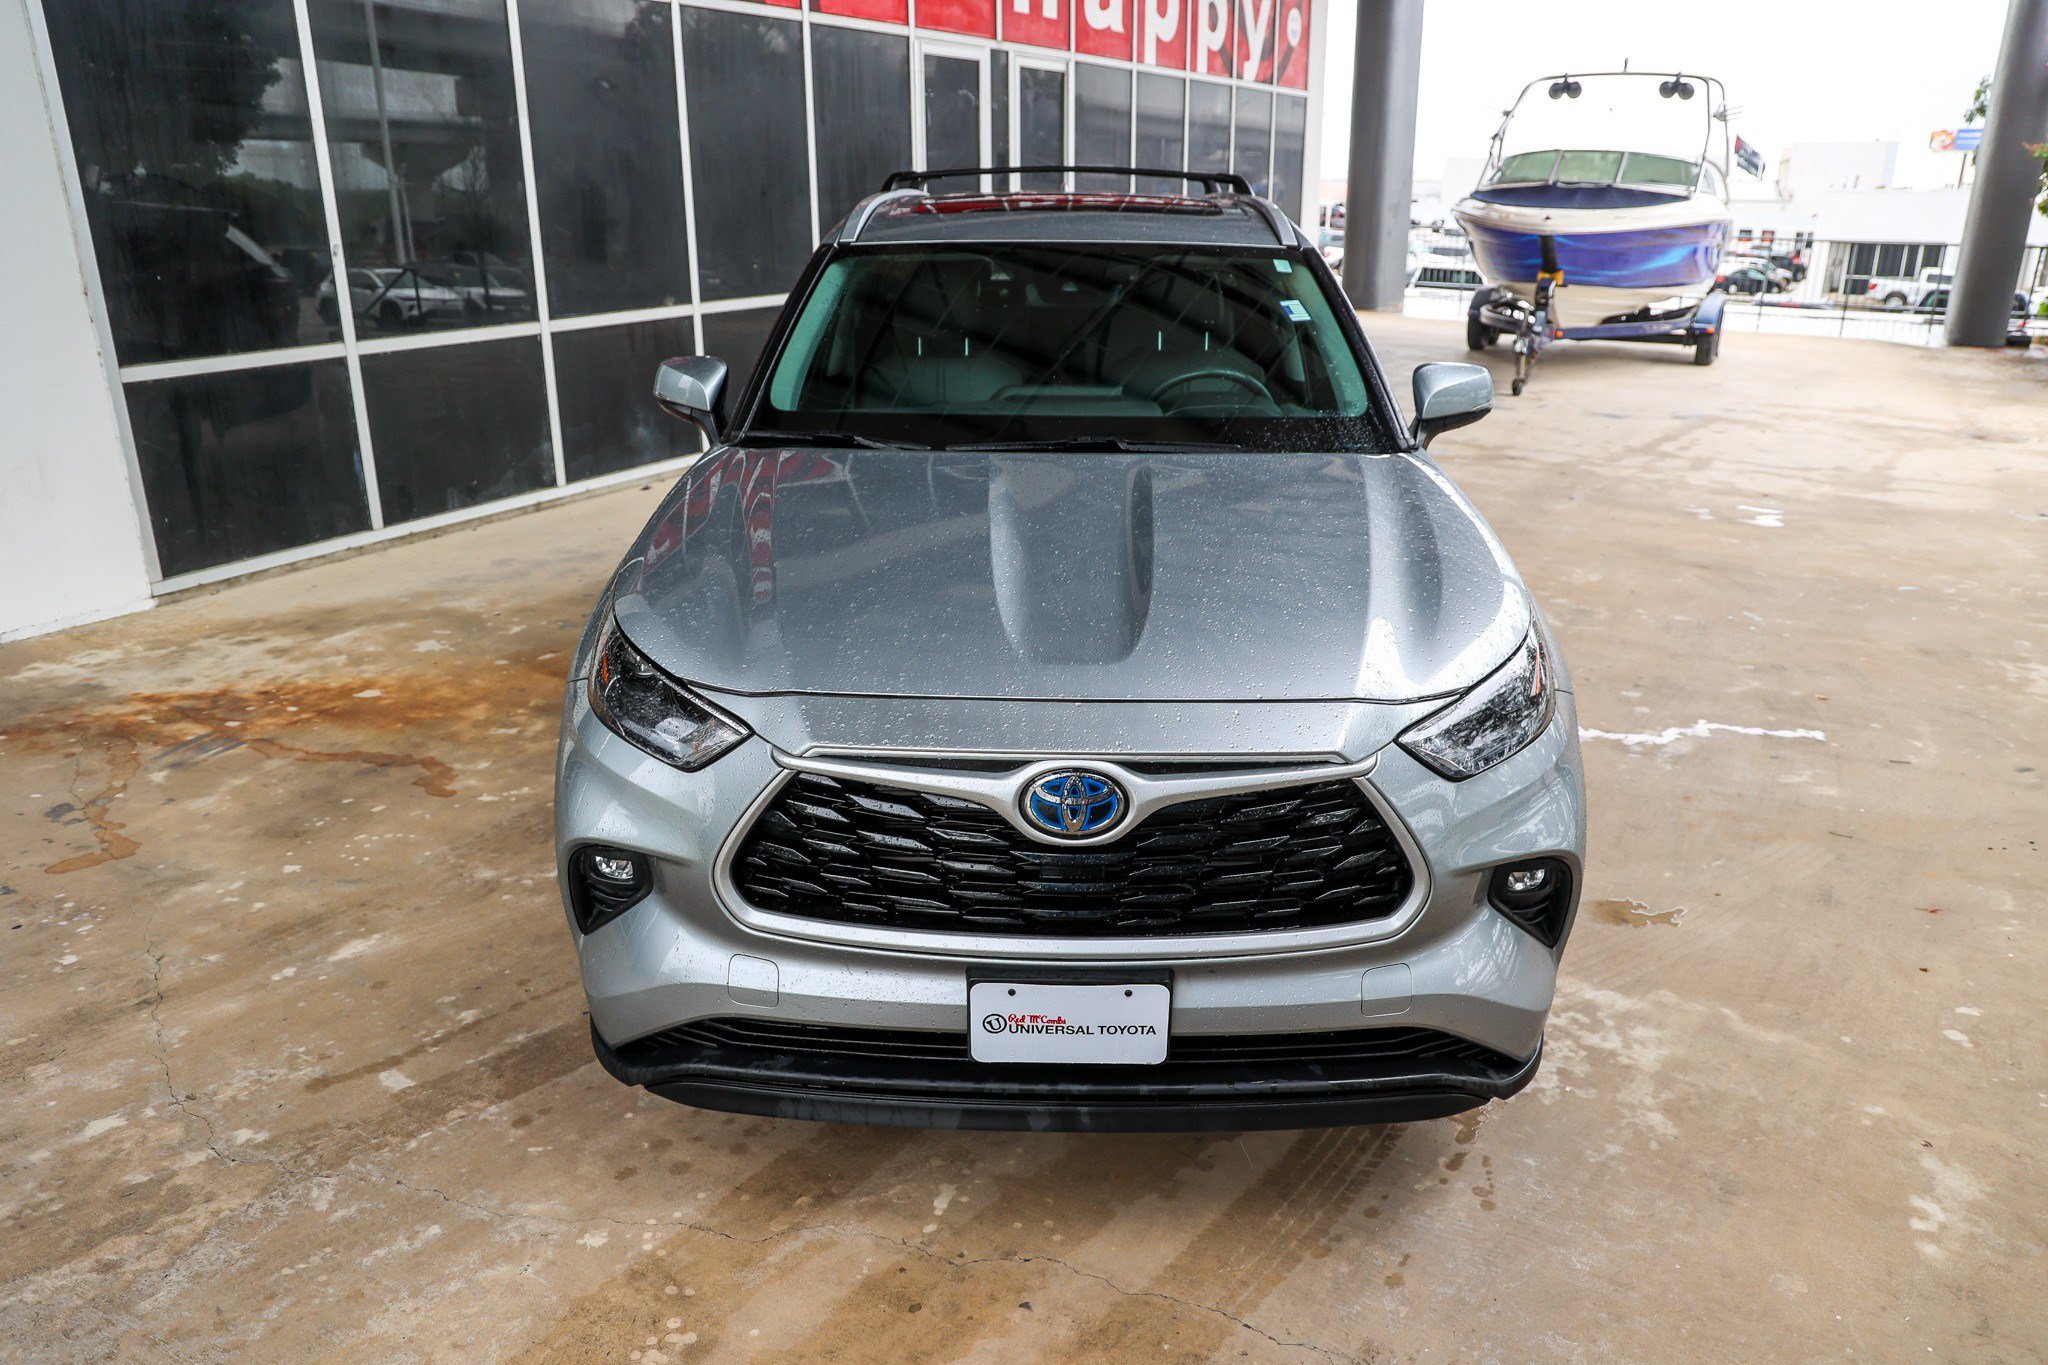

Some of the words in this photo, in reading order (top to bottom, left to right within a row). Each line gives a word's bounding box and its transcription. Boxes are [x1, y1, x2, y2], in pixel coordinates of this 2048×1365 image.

[1012, 0, 1302, 81] appy.
[1008, 1013, 1026, 1026] Red
[1008, 1023, 1095, 1035] UNIVERSAL
[1097, 1025, 1157, 1035] TOYOTA
